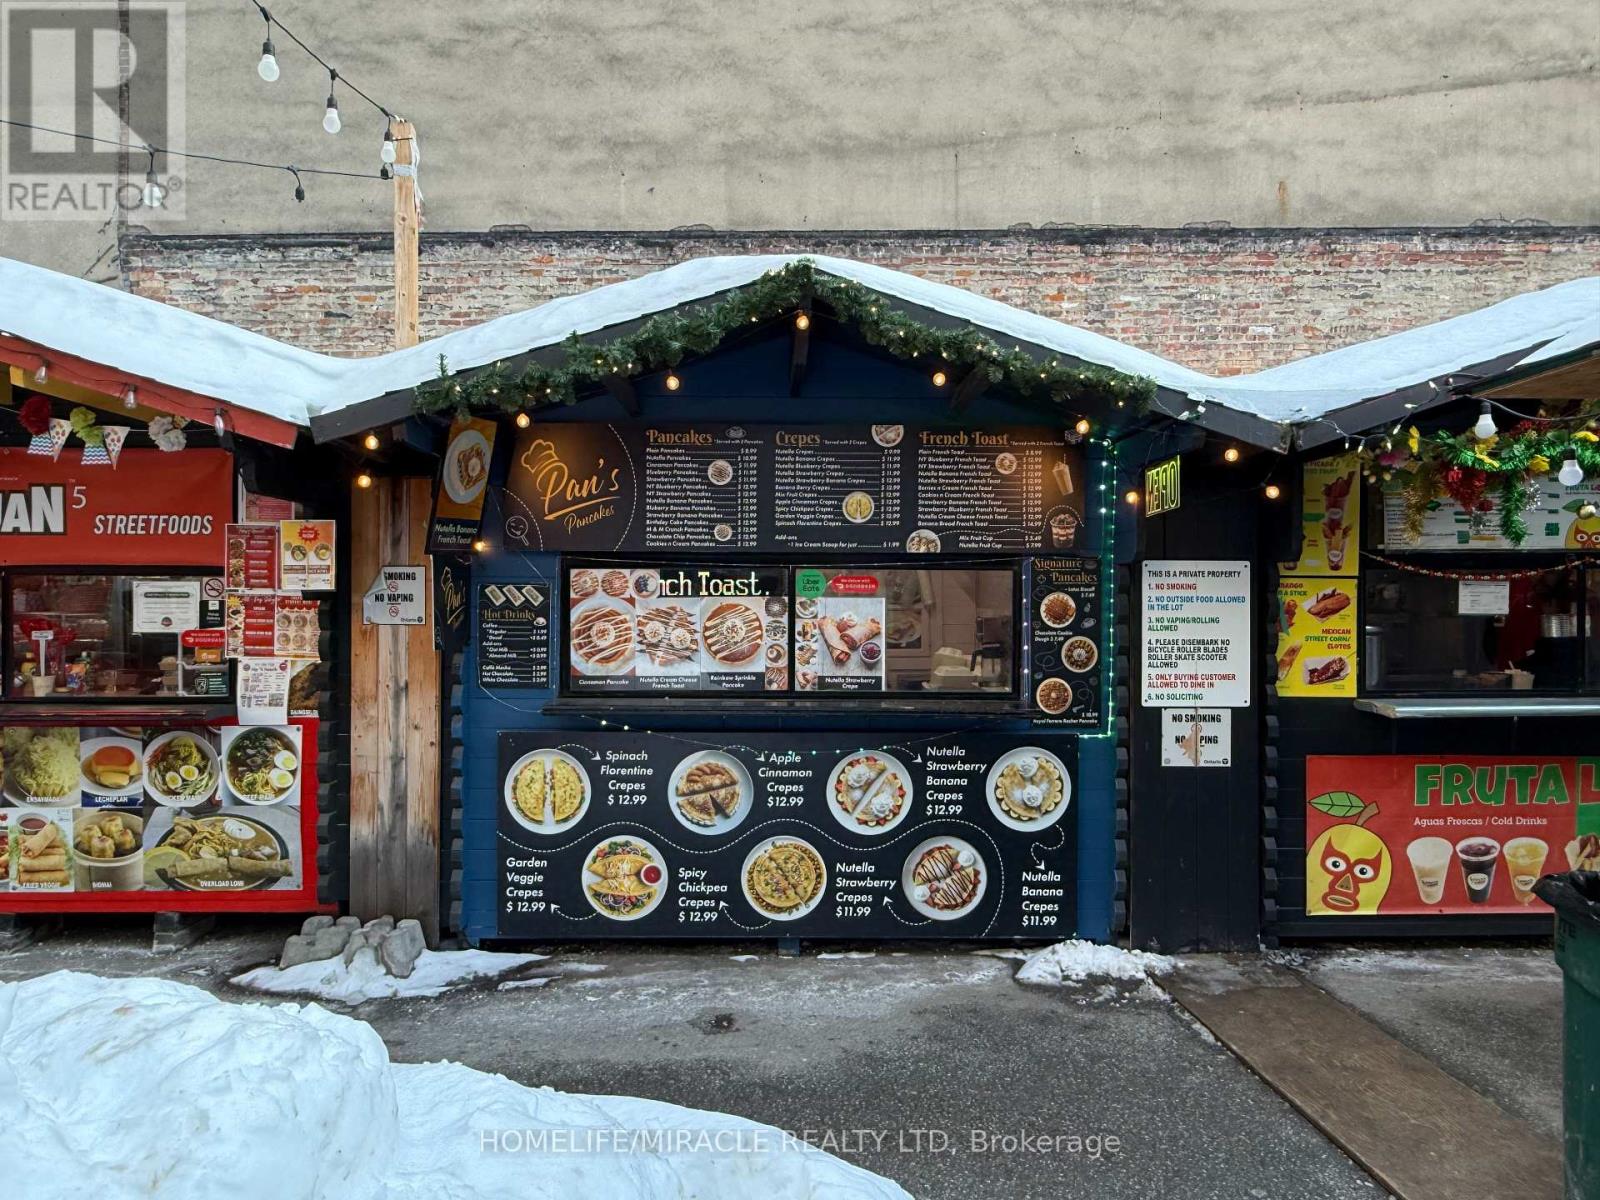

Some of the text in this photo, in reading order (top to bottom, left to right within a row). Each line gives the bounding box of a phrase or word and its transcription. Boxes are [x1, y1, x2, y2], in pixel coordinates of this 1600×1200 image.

[646, 429, 712, 444] Pancakes
[776, 431, 820, 446] Crepes
[920, 431, 1009, 446] French Toast
[537, 459, 619, 514] Pan's
[0, 486, 86, 532] AN 5
[94, 514, 213, 535] STREETFOODS
[564, 505, 614, 534] Pancakes
[435, 524, 477, 534] Nutella Banana
[438, 535, 457, 544] French
[1035, 559, 1082, 569] Signature
[1051, 572, 1097, 583] Pancakes
[698, 572, 769, 596] Toast.
[375, 594, 414, 602] NO VAPING
[483, 609, 535, 620] Hot Drinks
[1172, 714, 1221, 723] NO SMOKING
[1175, 736, 1185, 744] NO
[606, 750, 648, 762] Spinach
[927, 746, 965, 756] Nutella
[769, 752, 801, 765] Apple
[601, 765, 653, 775] Florentine
[758, 768, 812, 777] Cinnamon
[926, 760, 987, 773] Strawberry
[608, 780, 645, 792] Crepes
[926, 776, 968, 785] Banana
[1415, 764, 1570, 806] FRUTA
[767, 782, 803, 794] Crepes
[608, 794, 647, 806] $ 12.99
[767, 796, 804, 807] $12.99
[926, 790, 962, 805] Crepes
[926, 804, 962, 816] $12.99
[1414, 816, 1547, 827] Aguas Frescas / Cold Drinks
[506, 857, 547, 867] Garden
[836, 862, 874, 872] Nutella
[507, 872, 543, 884] Veggie
[678, 868, 707, 880] Spicy
[1022, 871, 1060, 881] Nutella
[679, 882, 727, 894] Chickpea
[836, 877, 896, 890] Strawberry
[506, 887, 543, 899] Crepes
[1022, 886, 1063, 896] Banana
[678, 897, 715, 909] Crepes
[836, 892, 872, 904] Crepes
[506, 901, 545, 912] $ 12.99
[836, 906, 870, 918] $11.99
[1022, 901, 1058, 913] Crepes
[678, 911, 718, 922] $ 12.99
[1022, 915, 1057, 927] $11.99
